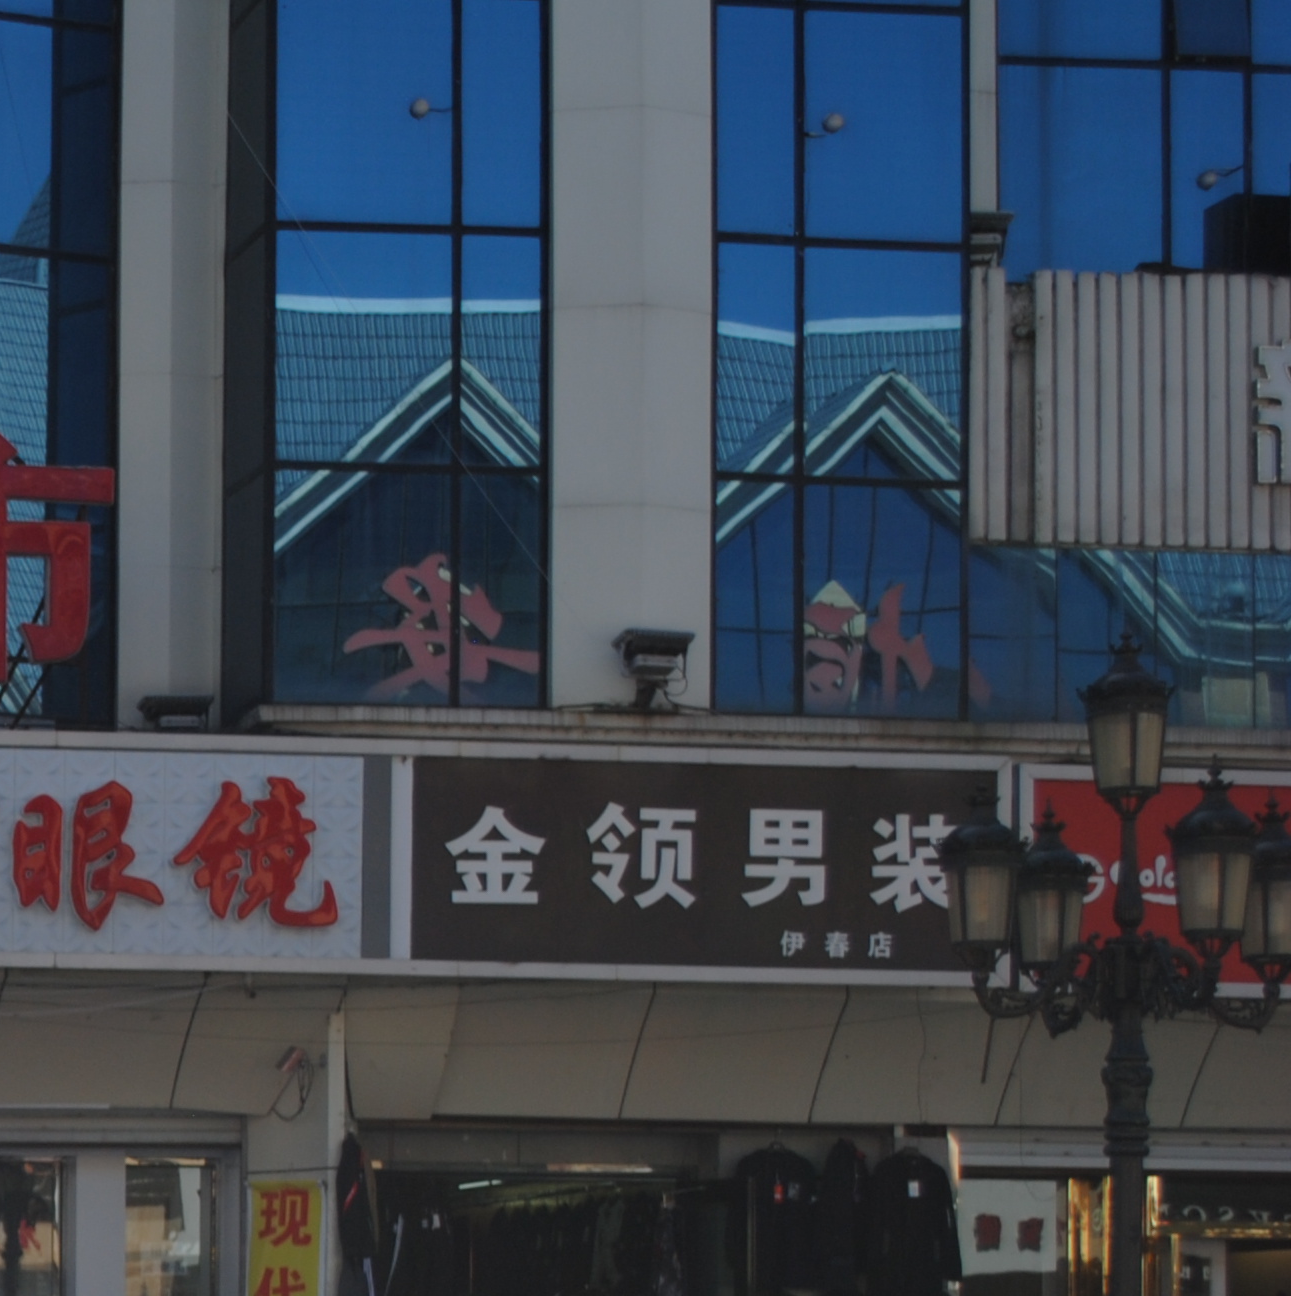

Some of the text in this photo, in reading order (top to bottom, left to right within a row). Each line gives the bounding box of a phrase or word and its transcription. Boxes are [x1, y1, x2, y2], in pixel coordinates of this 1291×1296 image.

[445, 802, 949, 913] 金领男装
[780, 929, 894, 959] 伊春店
